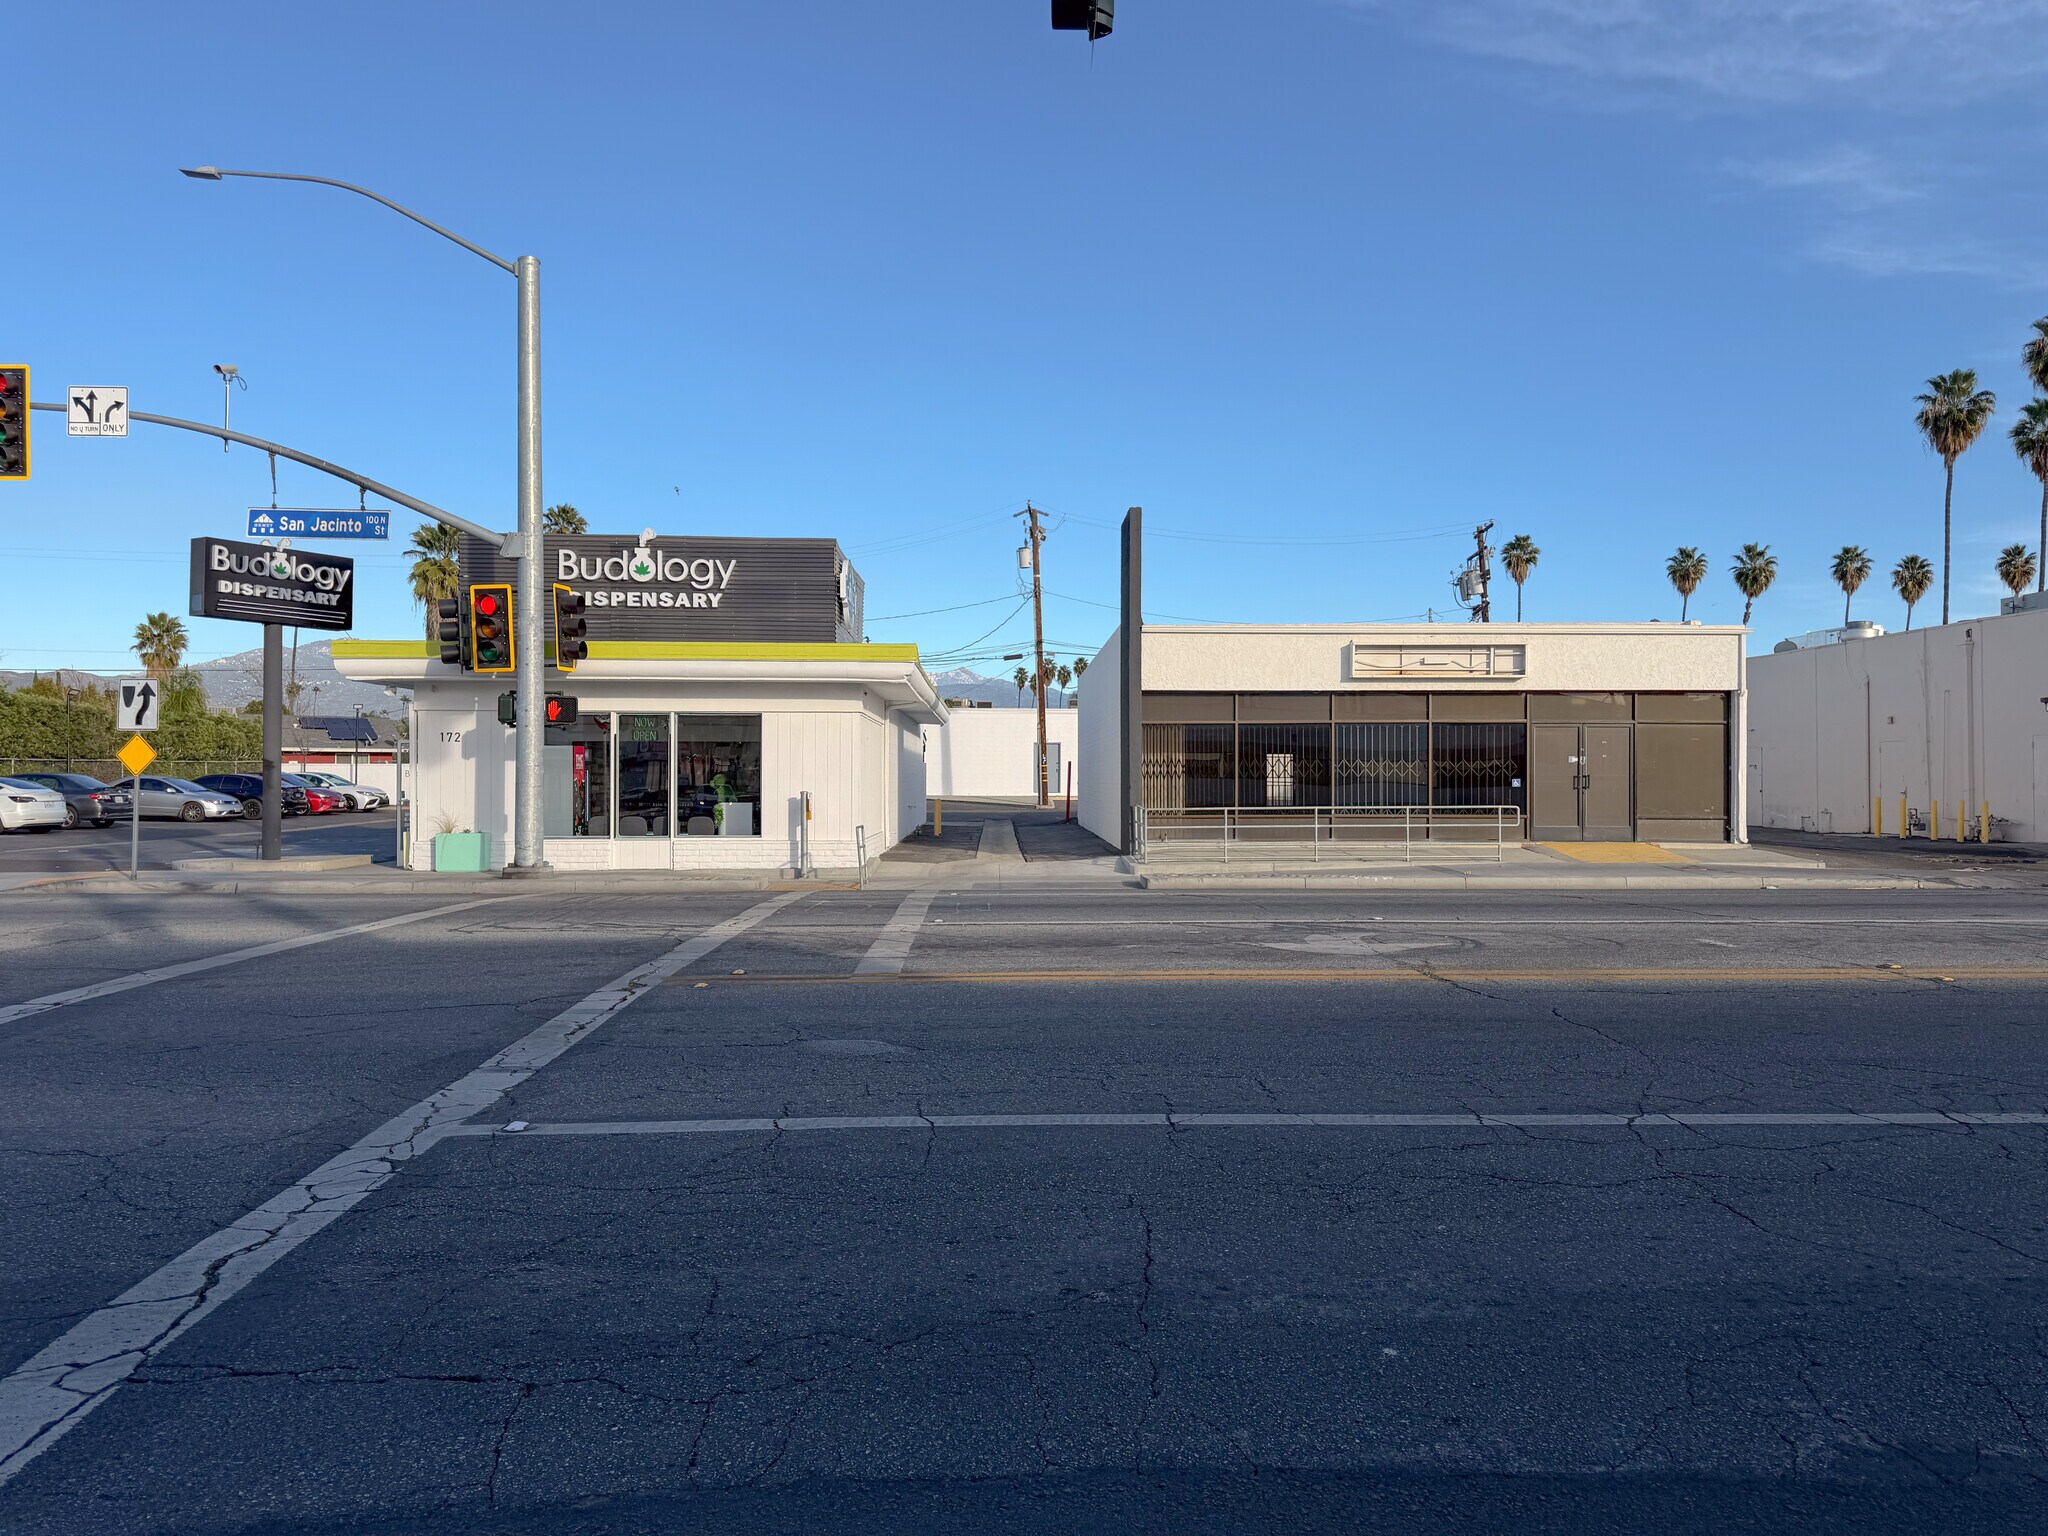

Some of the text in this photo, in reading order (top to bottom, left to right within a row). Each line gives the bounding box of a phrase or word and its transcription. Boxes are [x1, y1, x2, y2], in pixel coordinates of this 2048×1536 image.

[103, 424, 124, 433] ONLY
[279, 516, 362, 532] San Jacinto
[366, 516, 379, 524] 100
[374, 526, 385, 535] St
[209, 544, 351, 592] Budology
[558, 547, 737, 590] Budology
[217, 580, 341, 606] DISPENSARY
[571, 591, 723, 608] ISPENSARY
[634, 717, 656, 727] NOW
[440, 732, 461, 743] 172
[633, 731, 657, 741] OPEN
